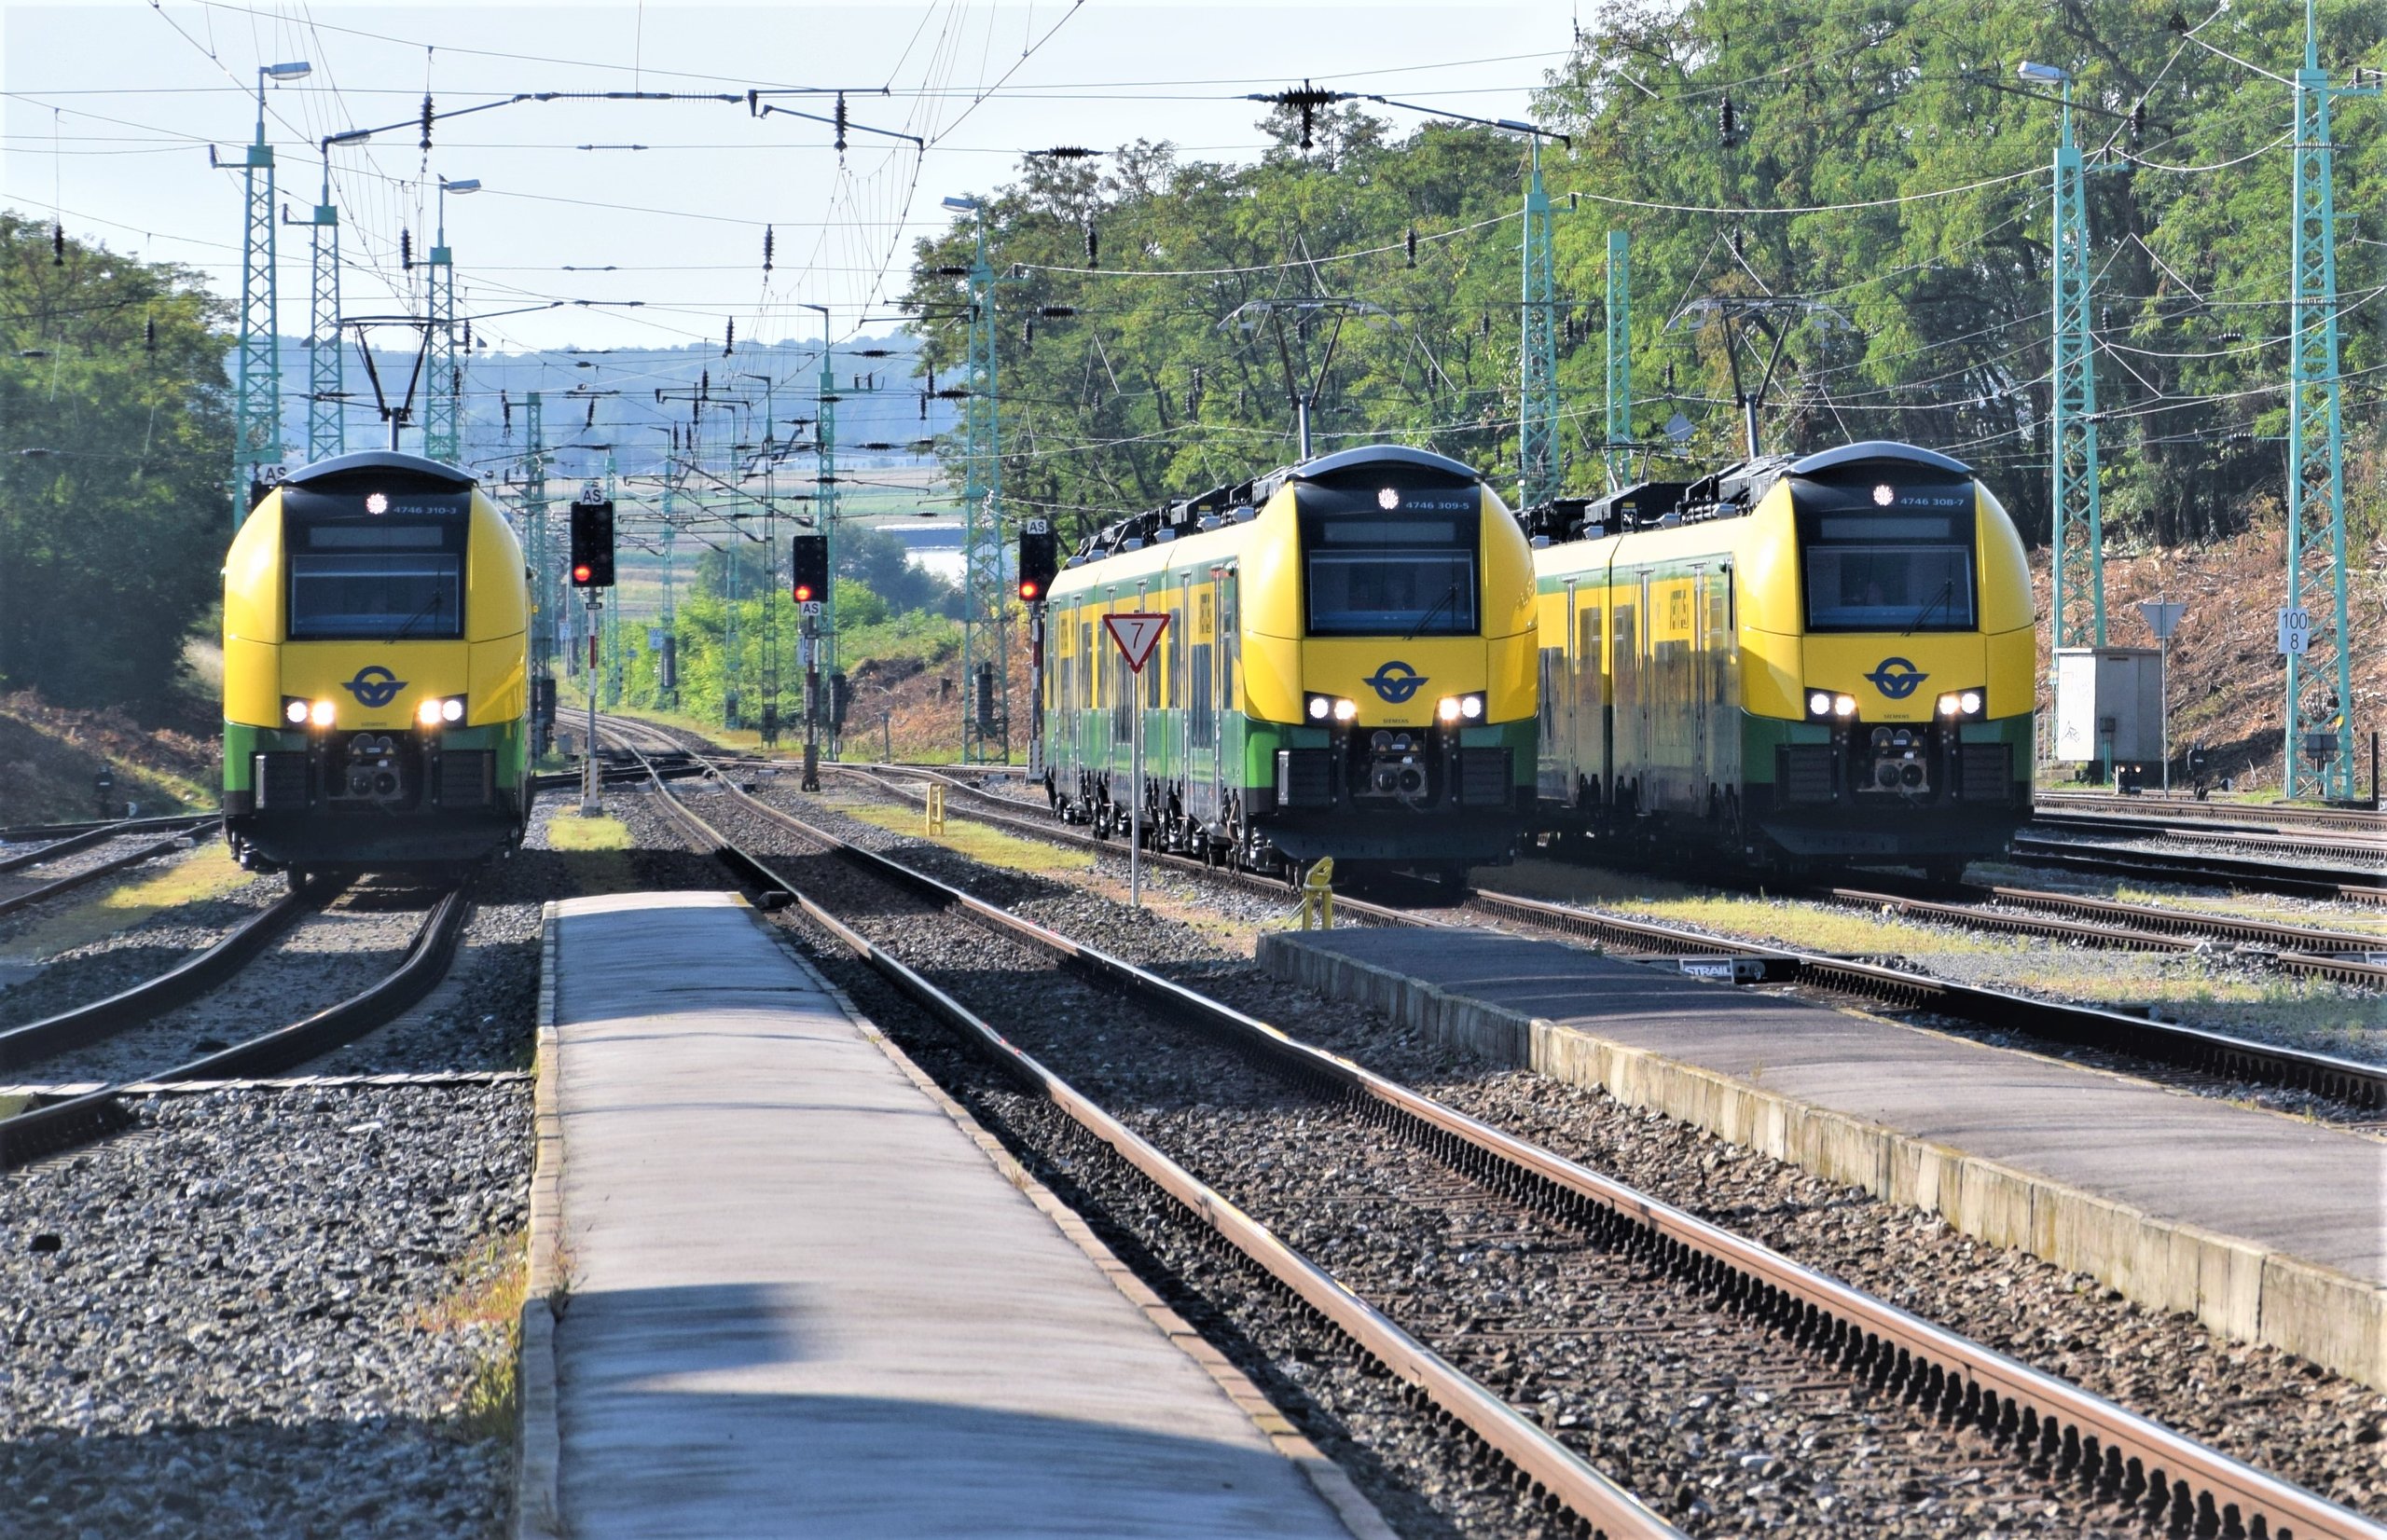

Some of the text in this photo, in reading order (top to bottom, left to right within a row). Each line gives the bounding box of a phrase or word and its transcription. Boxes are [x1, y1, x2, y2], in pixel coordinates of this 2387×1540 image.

[265, 466, 286, 481] AS
[583, 489, 601, 502] AS
[1438, 502, 1469, 510] 309-5
[1900, 498, 1964, 506] 4746 308-7
[1028, 521, 1044, 532] AS
[803, 602, 819, 613] AS
[2283, 612, 2308, 629] 100
[1130, 622, 1144, 650] 7
[2290, 633, 2298, 650] 8
[1684, 965, 1732, 977] STRAIL
